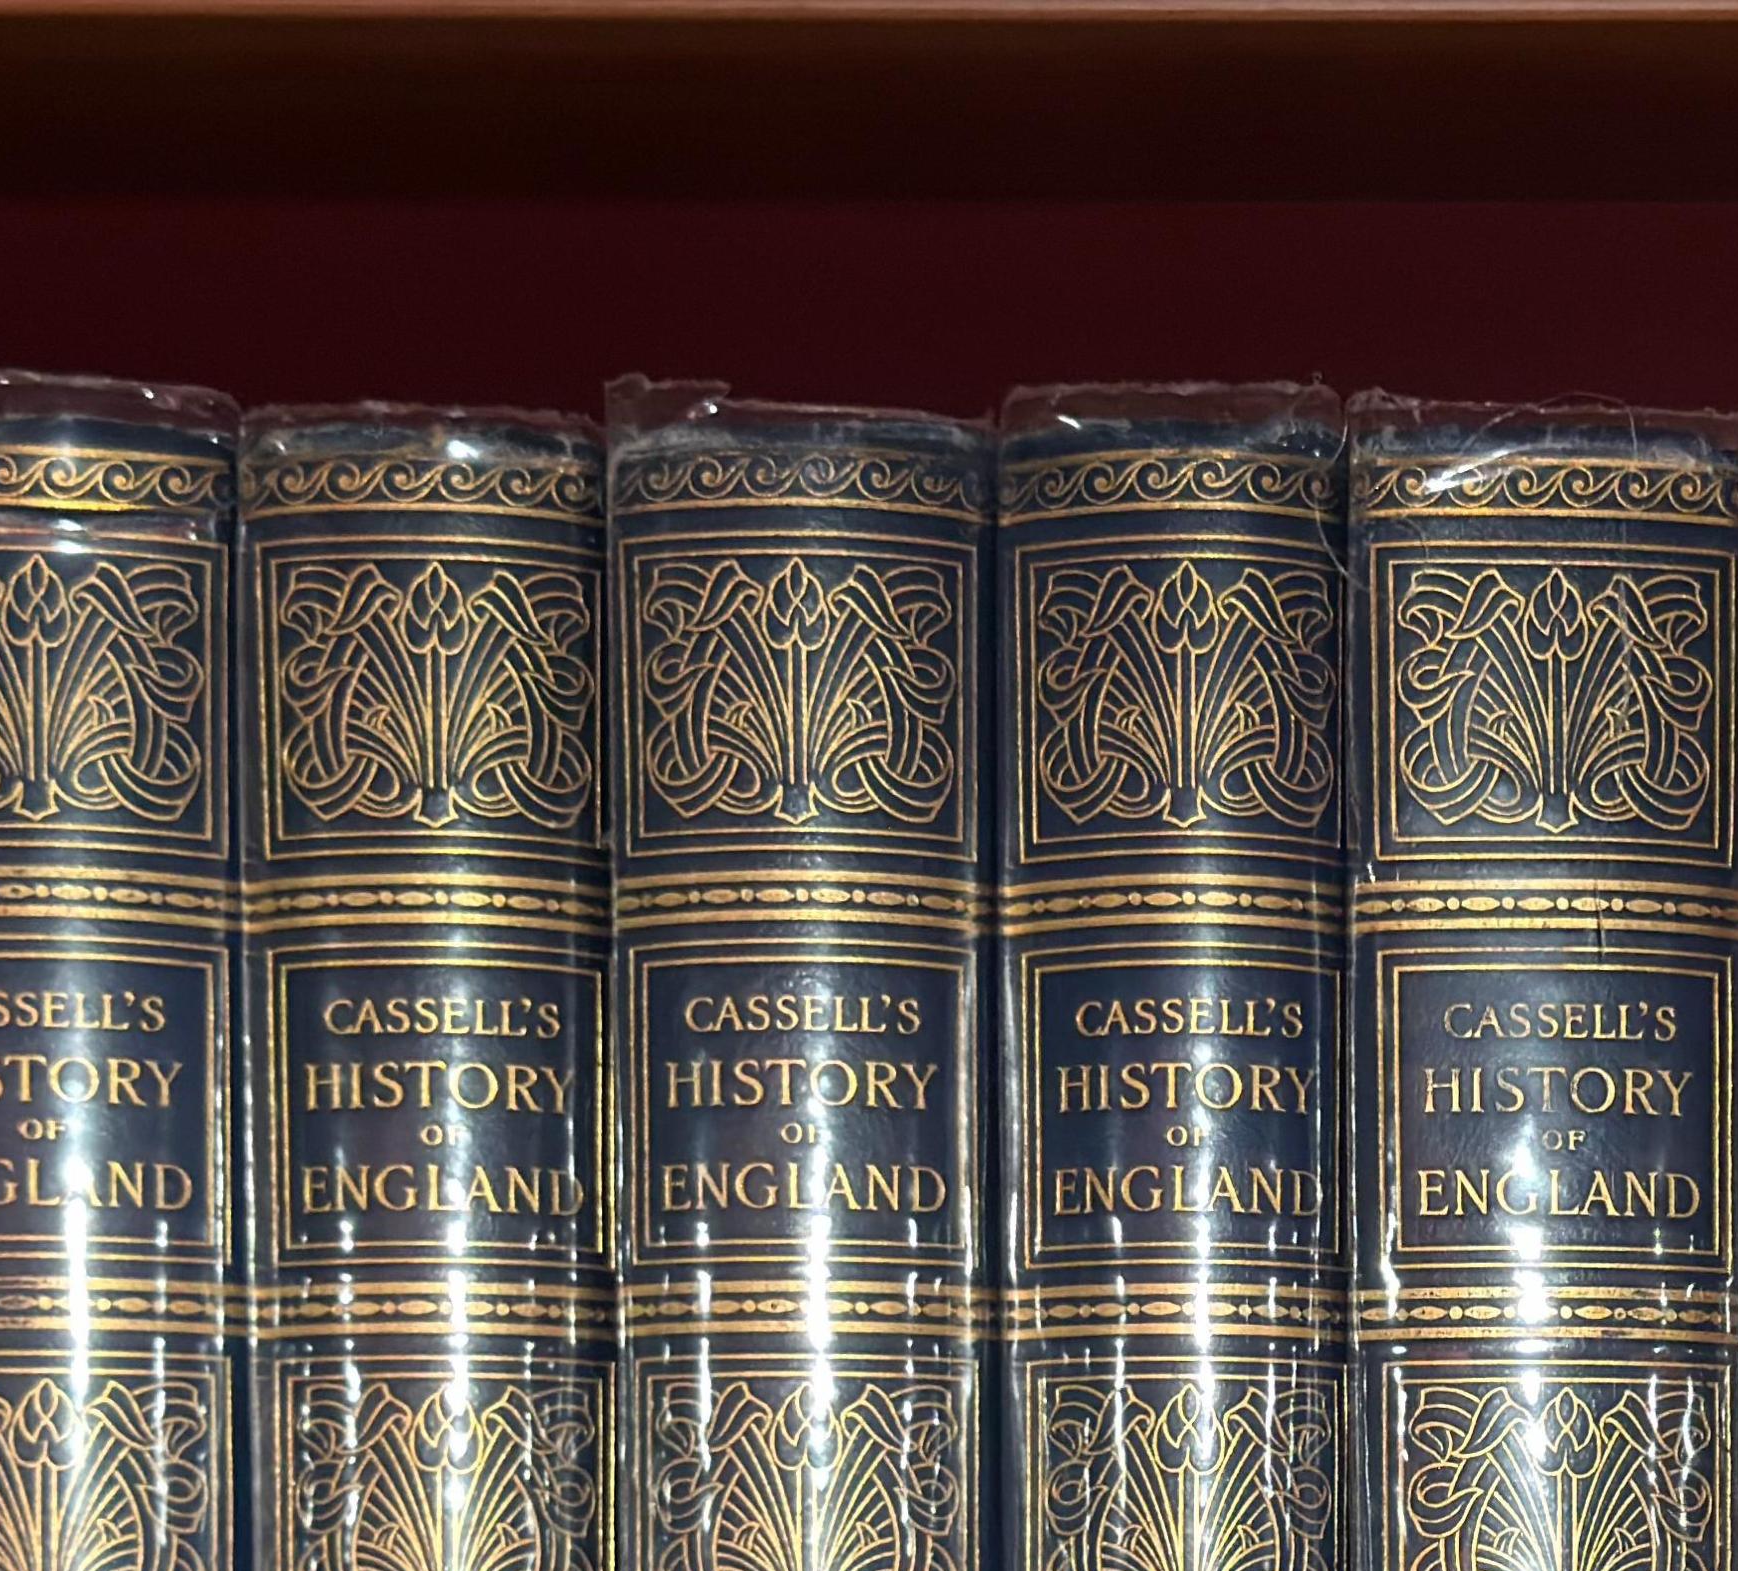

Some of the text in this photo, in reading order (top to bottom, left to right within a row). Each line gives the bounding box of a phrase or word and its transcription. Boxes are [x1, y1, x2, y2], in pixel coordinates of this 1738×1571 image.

[323, 997, 561, 1038] CASSELL'S
[685, 995, 922, 1034] CASSELL'S
[1076, 998, 1303, 1038] CASSELL'S
[1444, 1001, 1676, 1041] CASSELL'S
[304, 1061, 574, 1114] HISTORY
[665, 1059, 939, 1110] HISTORY
[1057, 1063, 1314, 1115] HISTORY
[1423, 1067, 1693, 1117] HISTORY
[17, 1119, 67, 1140] OF
[421, 1124, 464, 1146] OF
[1542, 1130, 1586, 1151] OF
[302, 1164, 585, 1216] ENGLAND
[662, 1162, 947, 1212] ENGLAND
[1054, 1166, 1322, 1216] ENGLAND
[1418, 1169, 1701, 1218] ENGLAND
